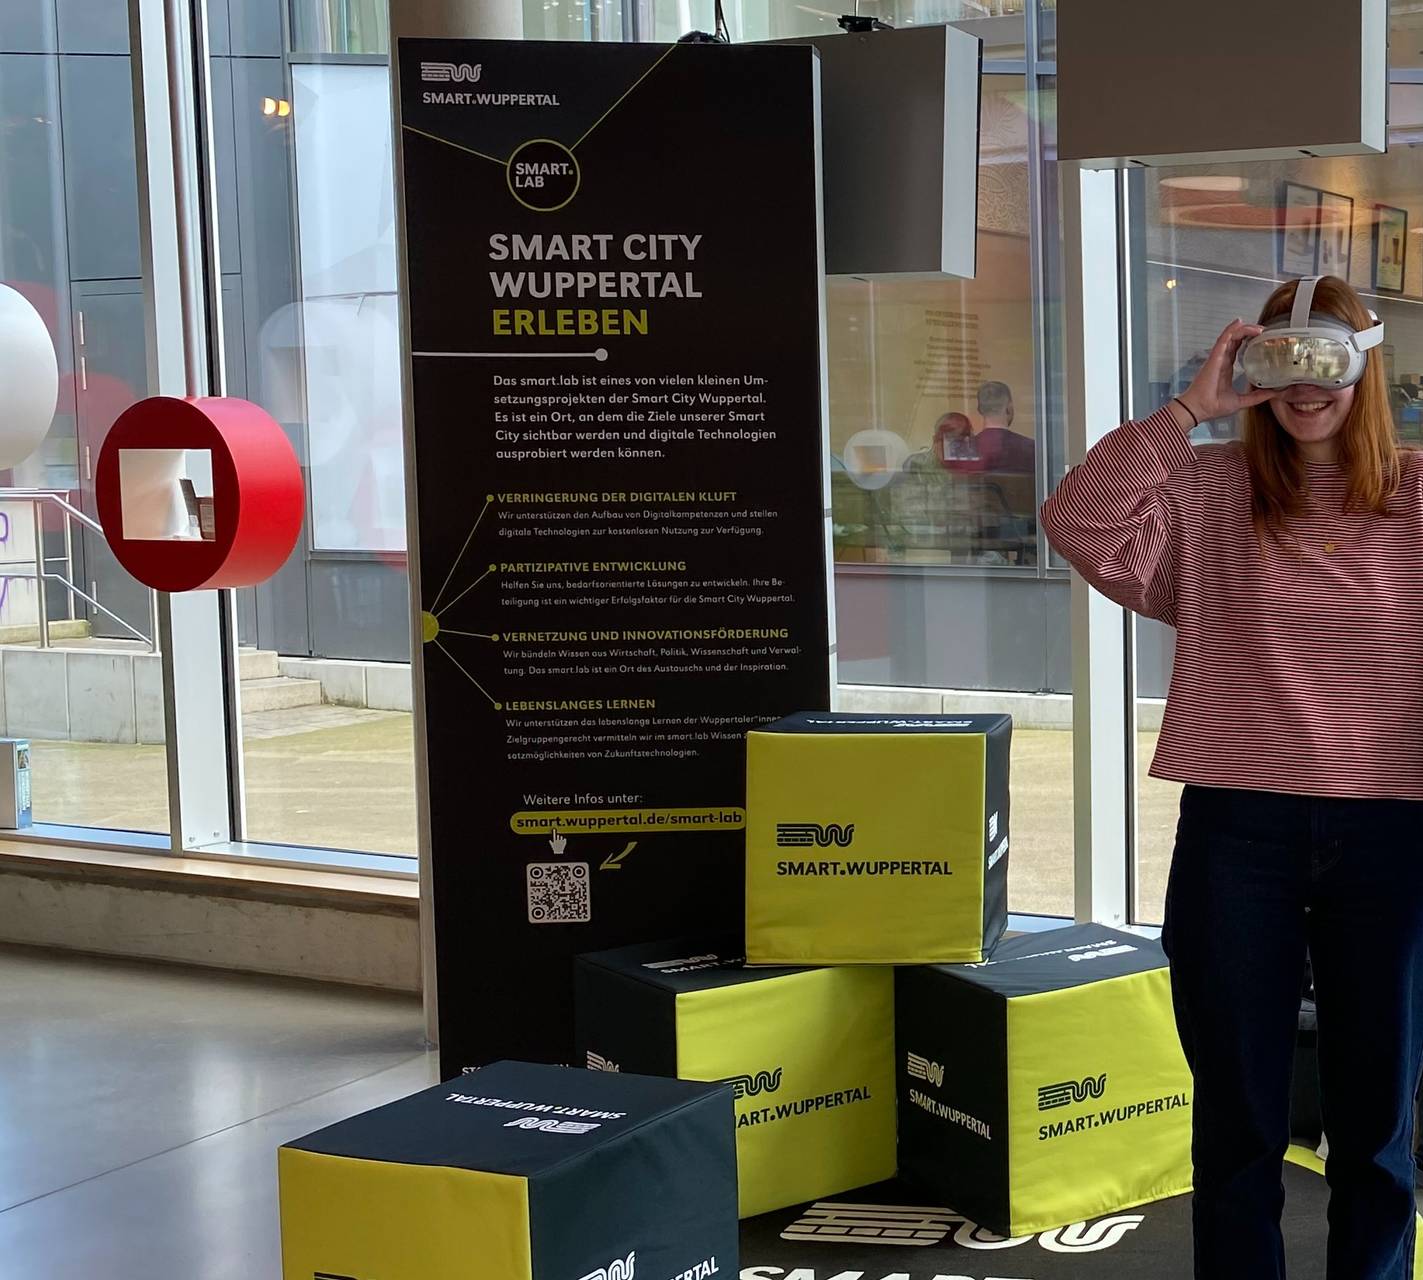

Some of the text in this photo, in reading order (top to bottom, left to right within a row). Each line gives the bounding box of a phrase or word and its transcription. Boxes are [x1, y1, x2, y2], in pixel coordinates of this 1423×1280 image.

[423, 92, 560, 106] SMART.WUPPERTAL
[515, 176, 545, 188] LAB
[488, 233, 703, 261] SMART CITY
[489, 271, 703, 299] WUPPERTAL
[493, 309, 648, 335] ERLEBEN
[493, 375, 769, 387] Das smart.lab ist eines von vielen kleinen Um-
[494, 393, 766, 406] setzungsprojekten der Smart City Wuppertal.
[494, 411, 508, 421] Es
[511, 411, 526, 421] ist
[529, 411, 548, 421] ein
[550, 411, 575, 423] Ort,
[597, 411, 623, 421] dem
[626, 411, 644, 421] die
[647, 411, 676, 421] Ziele
[679, 413, 725, 421] unserer
[728, 411, 764, 421] Smart
[495, 429, 776, 443] City sichtbar werden und digitale Technologien
[496, 447, 664, 460] ausprobiert werden können.
[497, 491, 736, 503] VERRINGERUNG DER DIGITALEN KLUFT
[498, 511, 513, 519] Wir
[516, 511, 571, 519] unterstützen
[572, 510, 589, 518] den
[591, 510, 623, 518] Aufbau
[642, 510, 729, 520] Digitalkompetenzen
[730, 509, 748, 517] und
[749, 509, 778, 517] stellen
[498, 527, 532, 538] digitale
[534, 527, 590, 538] Technologien
[608, 526, 659, 535] kostenlosen
[661, 526, 698, 537] Nutzung
[500, 561, 686, 572] PARTIZIPATIVE ENTWICKLUNG
[502, 628, 788, 642] VERNETZUNG UND INNOVATIONSFÖRDERUNG
[505, 699, 655, 711] LEBENSLANGES LERNEN
[523, 793, 643, 806] Weitere Infos unter:
[516, 812, 742, 829] smart.wuppertal.de/smart-lab
[776, 861, 953, 876] SMART.WUPPERTAL
[736, 1086, 872, 1129] ART.WUPPERTAL
[909, 1088, 992, 1141] SMART.WUPPERTAL
[1037, 1092, 1189, 1141] SMART.WUPPERTAL
